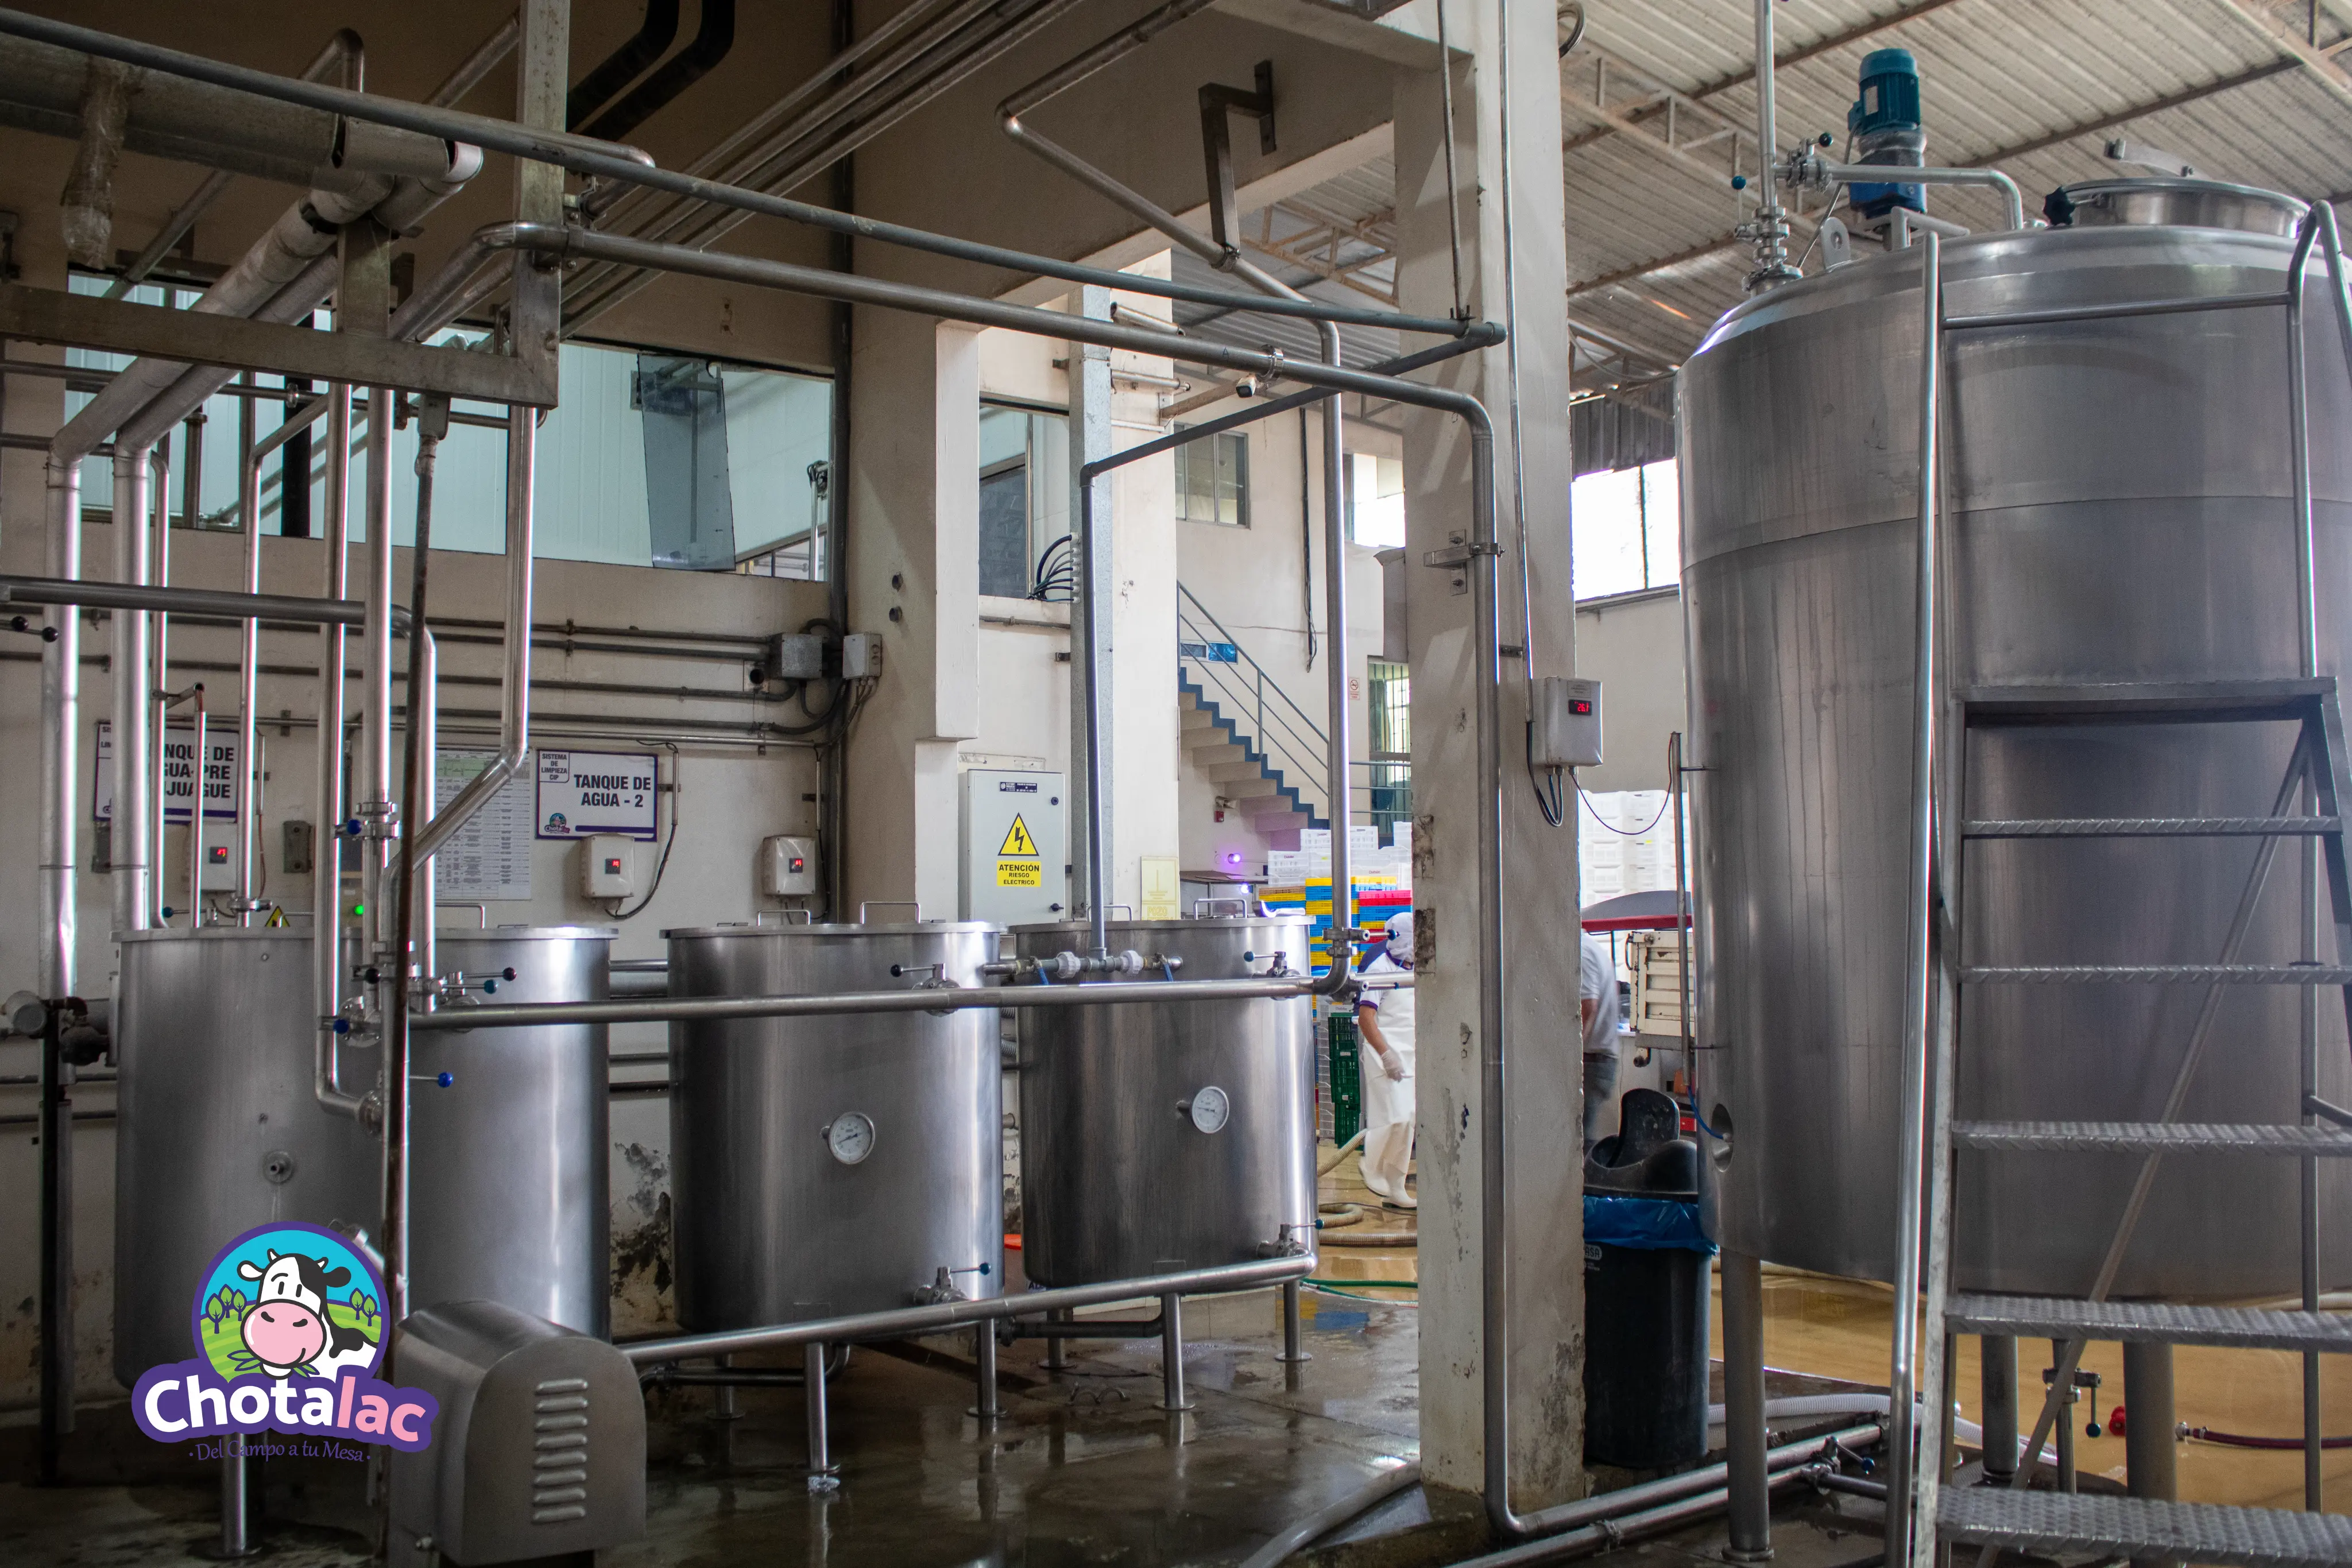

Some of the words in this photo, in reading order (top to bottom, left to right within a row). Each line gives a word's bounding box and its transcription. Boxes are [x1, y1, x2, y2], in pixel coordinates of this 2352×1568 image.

[213, 747, 234, 761] DE
[574, 775, 628, 791] TANQUE
[633, 777, 651, 790] DE
[581, 792, 620, 807] AGUA
[635, 794, 643, 807] 2
[999, 864, 1039, 872] ATENCIÓN
[1147, 907, 1168, 917] POZO
